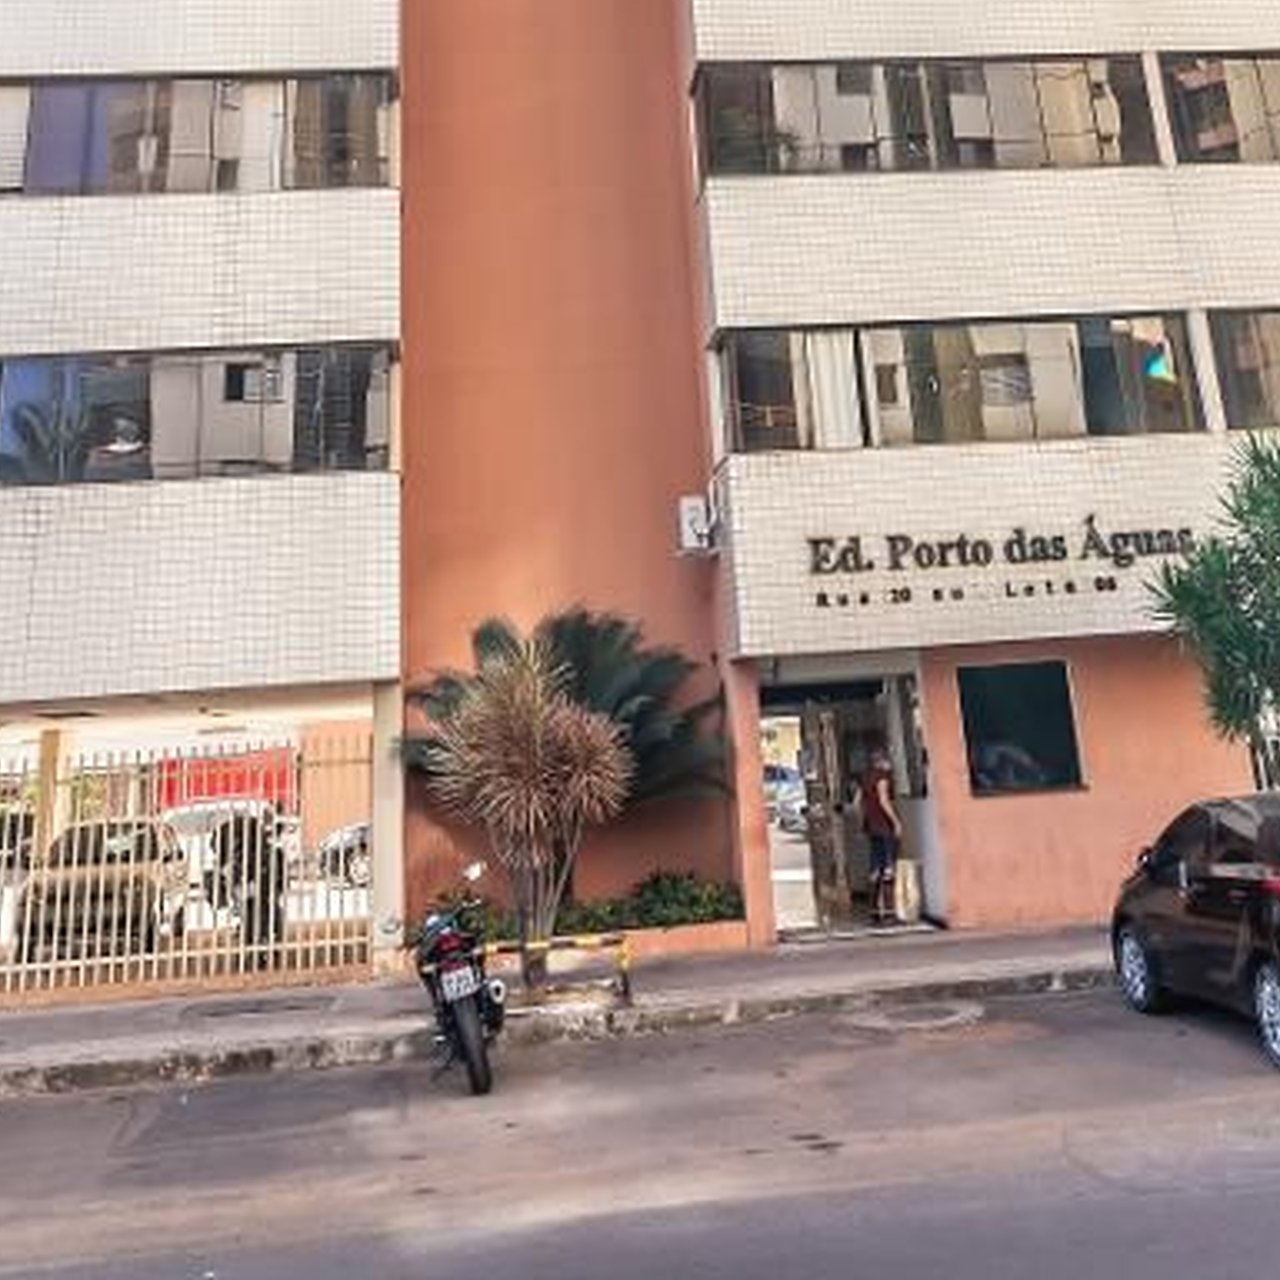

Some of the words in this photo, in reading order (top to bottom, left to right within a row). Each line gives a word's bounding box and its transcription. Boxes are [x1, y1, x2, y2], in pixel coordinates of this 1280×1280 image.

[807, 536, 875, 575] Ed.
[886, 533, 993, 570] Porto
[1004, 528, 1067, 564] das
[1078, 514, 1195, 568] Águas
